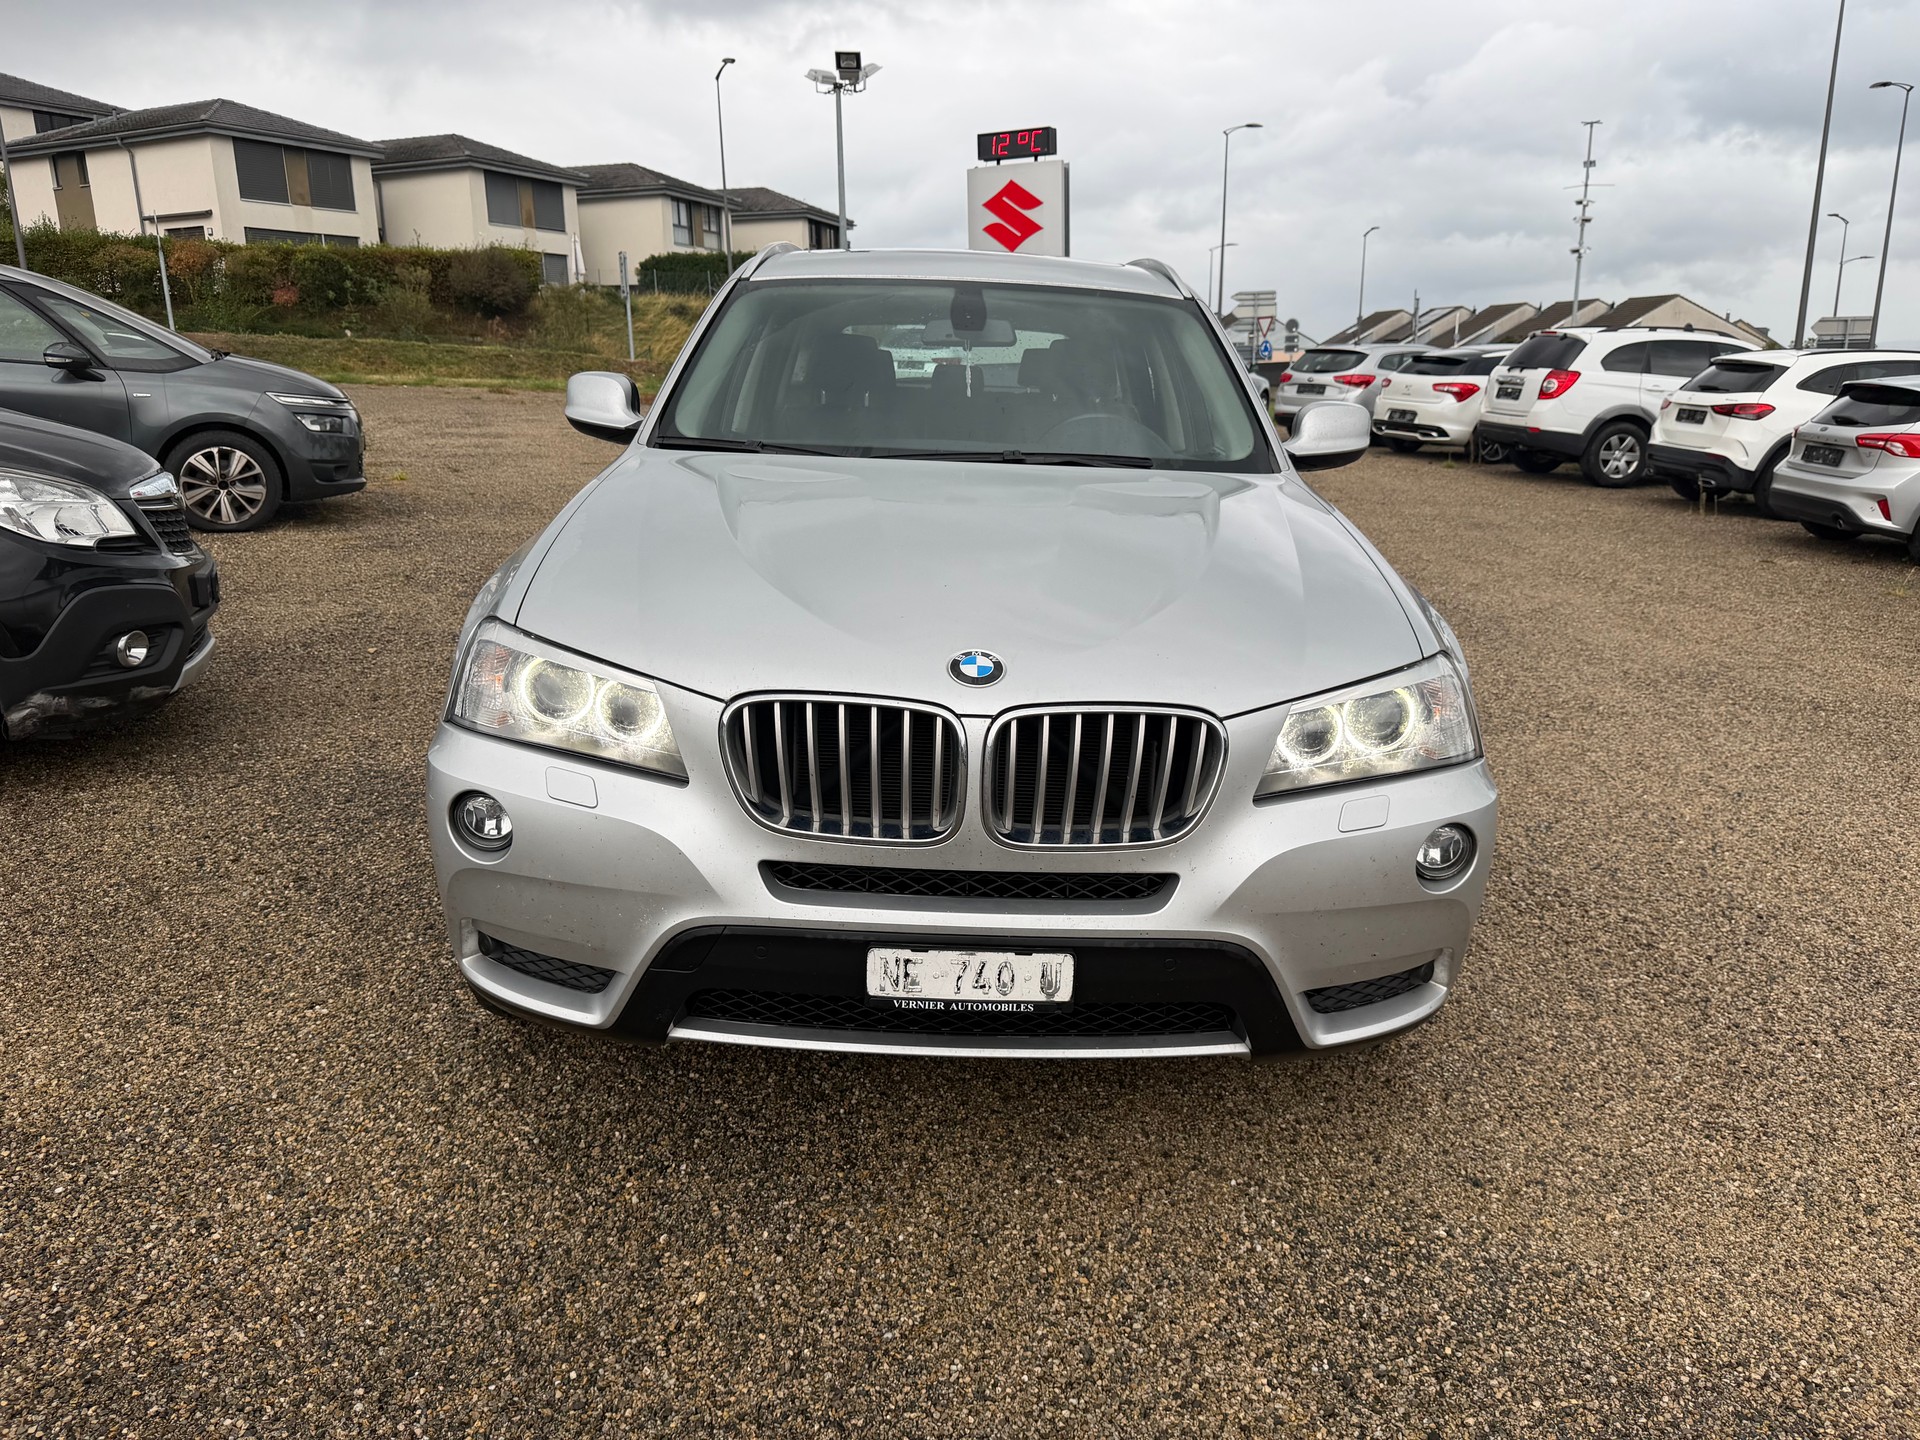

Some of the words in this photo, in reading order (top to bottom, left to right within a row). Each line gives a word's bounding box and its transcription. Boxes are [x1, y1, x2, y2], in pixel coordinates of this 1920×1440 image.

[992, 134, 1010, 155] 12
[954, 651, 999, 662] BMW
[879, 955, 924, 993] NE
[950, 959, 1015, 996] 740
[1039, 961, 1063, 998] U
[892, 999, 945, 1011] VERNIER
[949, 1002, 1035, 1013] AUTOMOBILES
